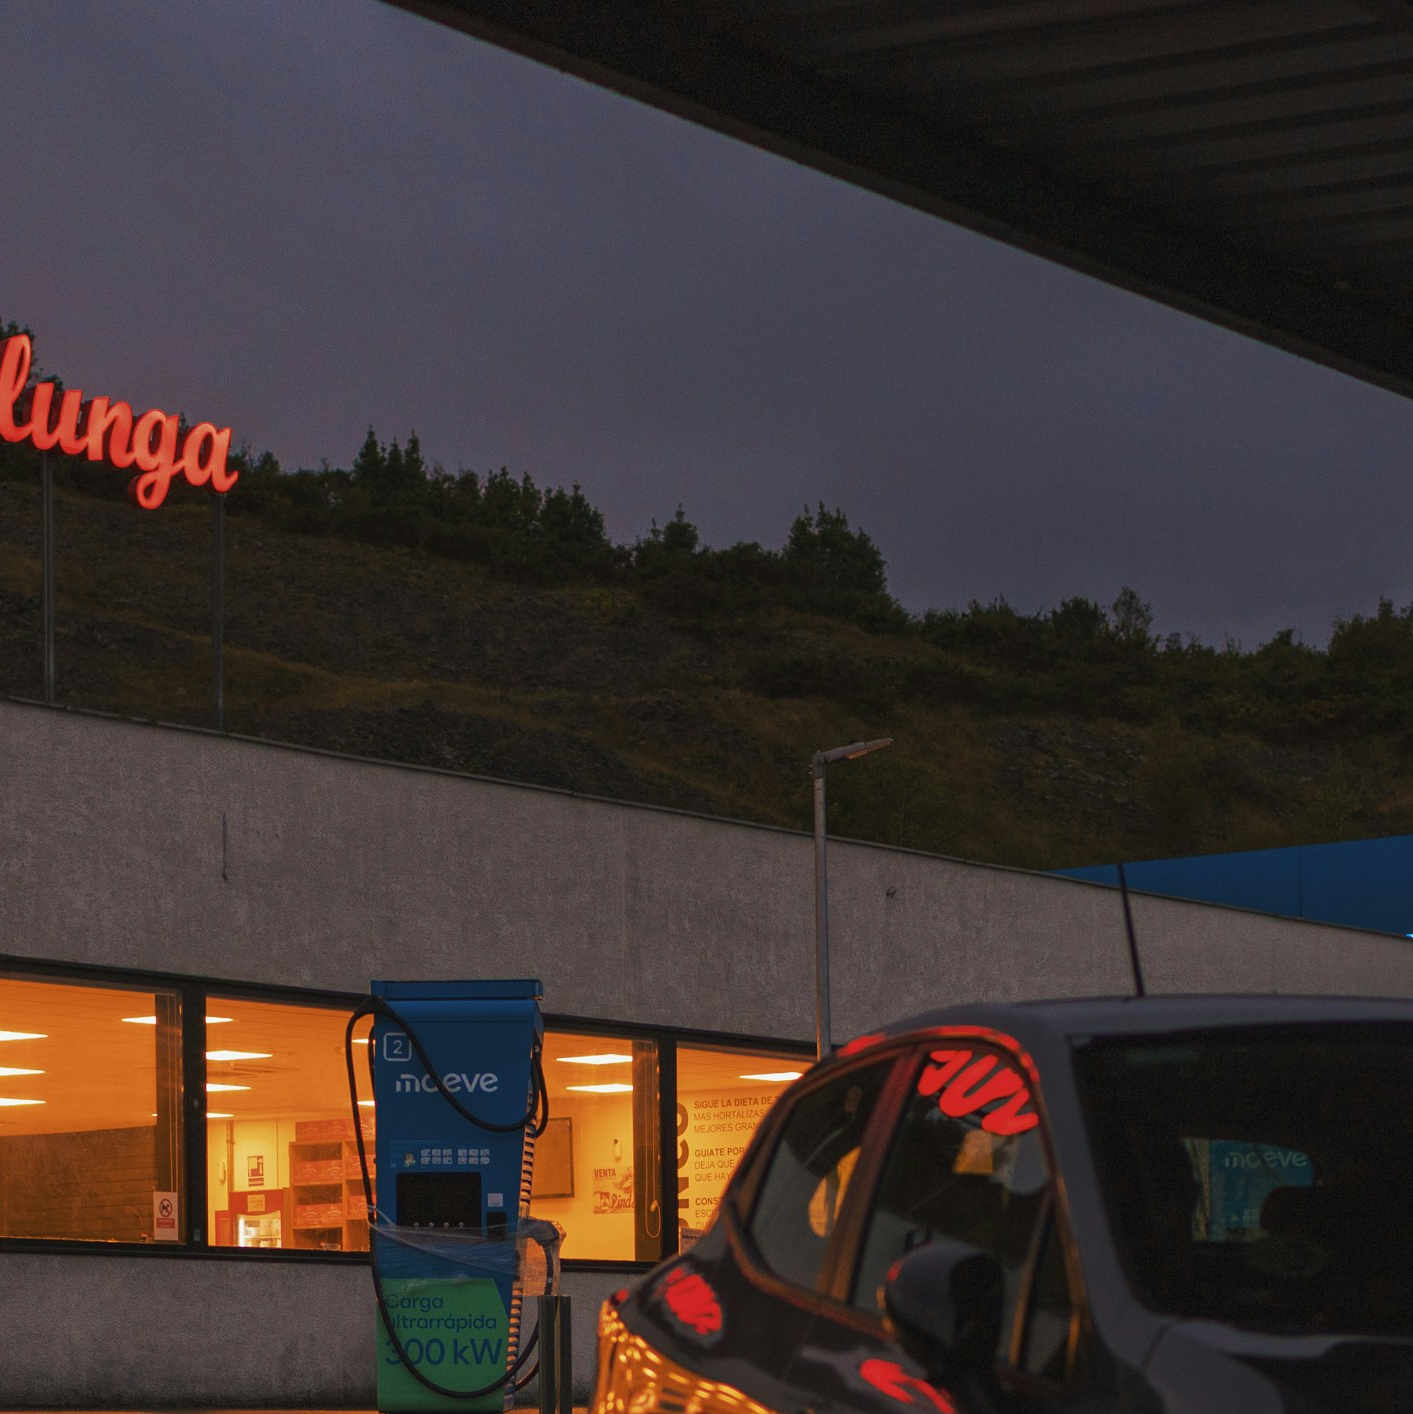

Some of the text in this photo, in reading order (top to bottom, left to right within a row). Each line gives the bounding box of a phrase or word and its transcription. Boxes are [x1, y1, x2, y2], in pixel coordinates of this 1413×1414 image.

[392, 1039, 403, 1055] 2
[395, 1072, 499, 1093] moeve
[693, 1100, 719, 1109] SIGUE
[721, 1099, 732, 1108] LA
[734, 1097, 759, 1107] DIETA
[761, 1096, 773, 1105] DE
[693, 1109, 765, 1121] MAS HORTALIZAS
[693, 1123, 733, 1134] MEJORES
[694, 1148, 725, 1157] GUIATE
[694, 1159, 735, 1170] DEJA QUE
[593, 1168, 616, 1178] VENTA
[695, 1172, 732, 1182] QUE HAY
[386, 1293, 443, 1312] Carga
[453, 1338, 503, 1366] kW
